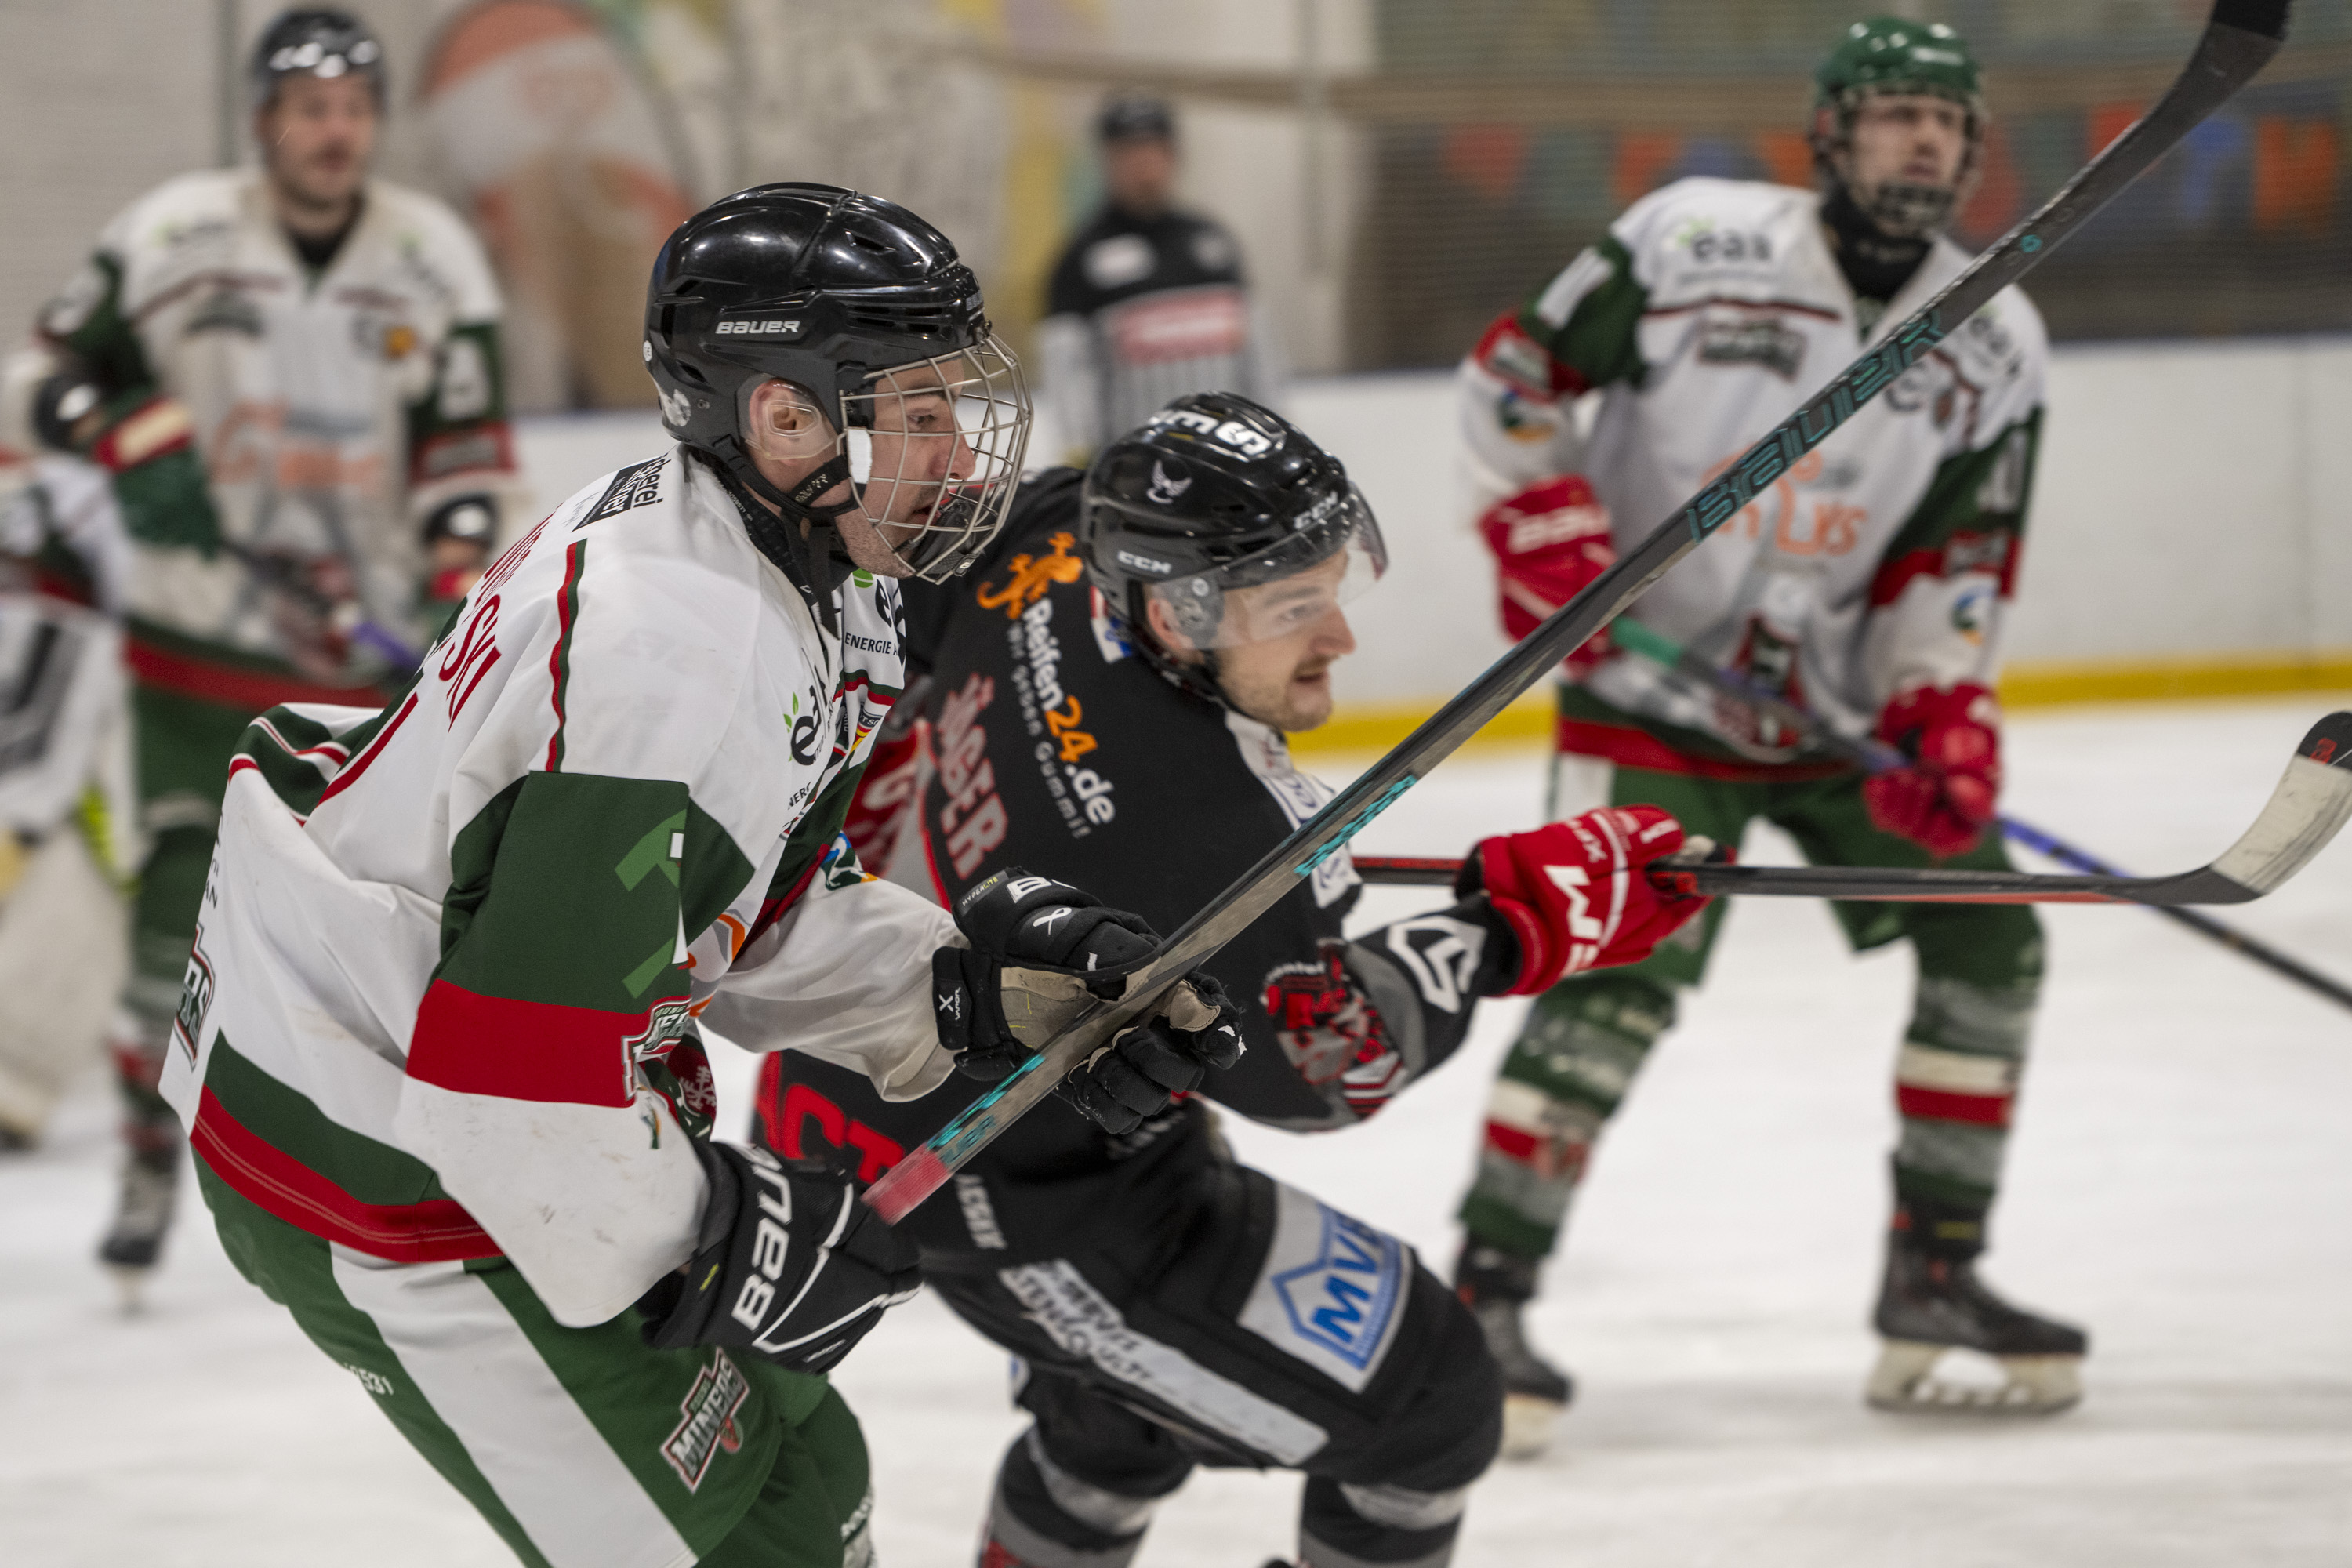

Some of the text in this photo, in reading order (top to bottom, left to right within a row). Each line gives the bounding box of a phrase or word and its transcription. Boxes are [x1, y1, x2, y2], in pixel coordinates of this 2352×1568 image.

[714, 320, 800, 335] BAUER
[1117, 550, 1172, 575] CCM
[844, 631, 892, 655] ENERGIE
[1022, 597, 1116, 825] Reifen24.de
[961, 876, 999, 907] HYPERLITE
